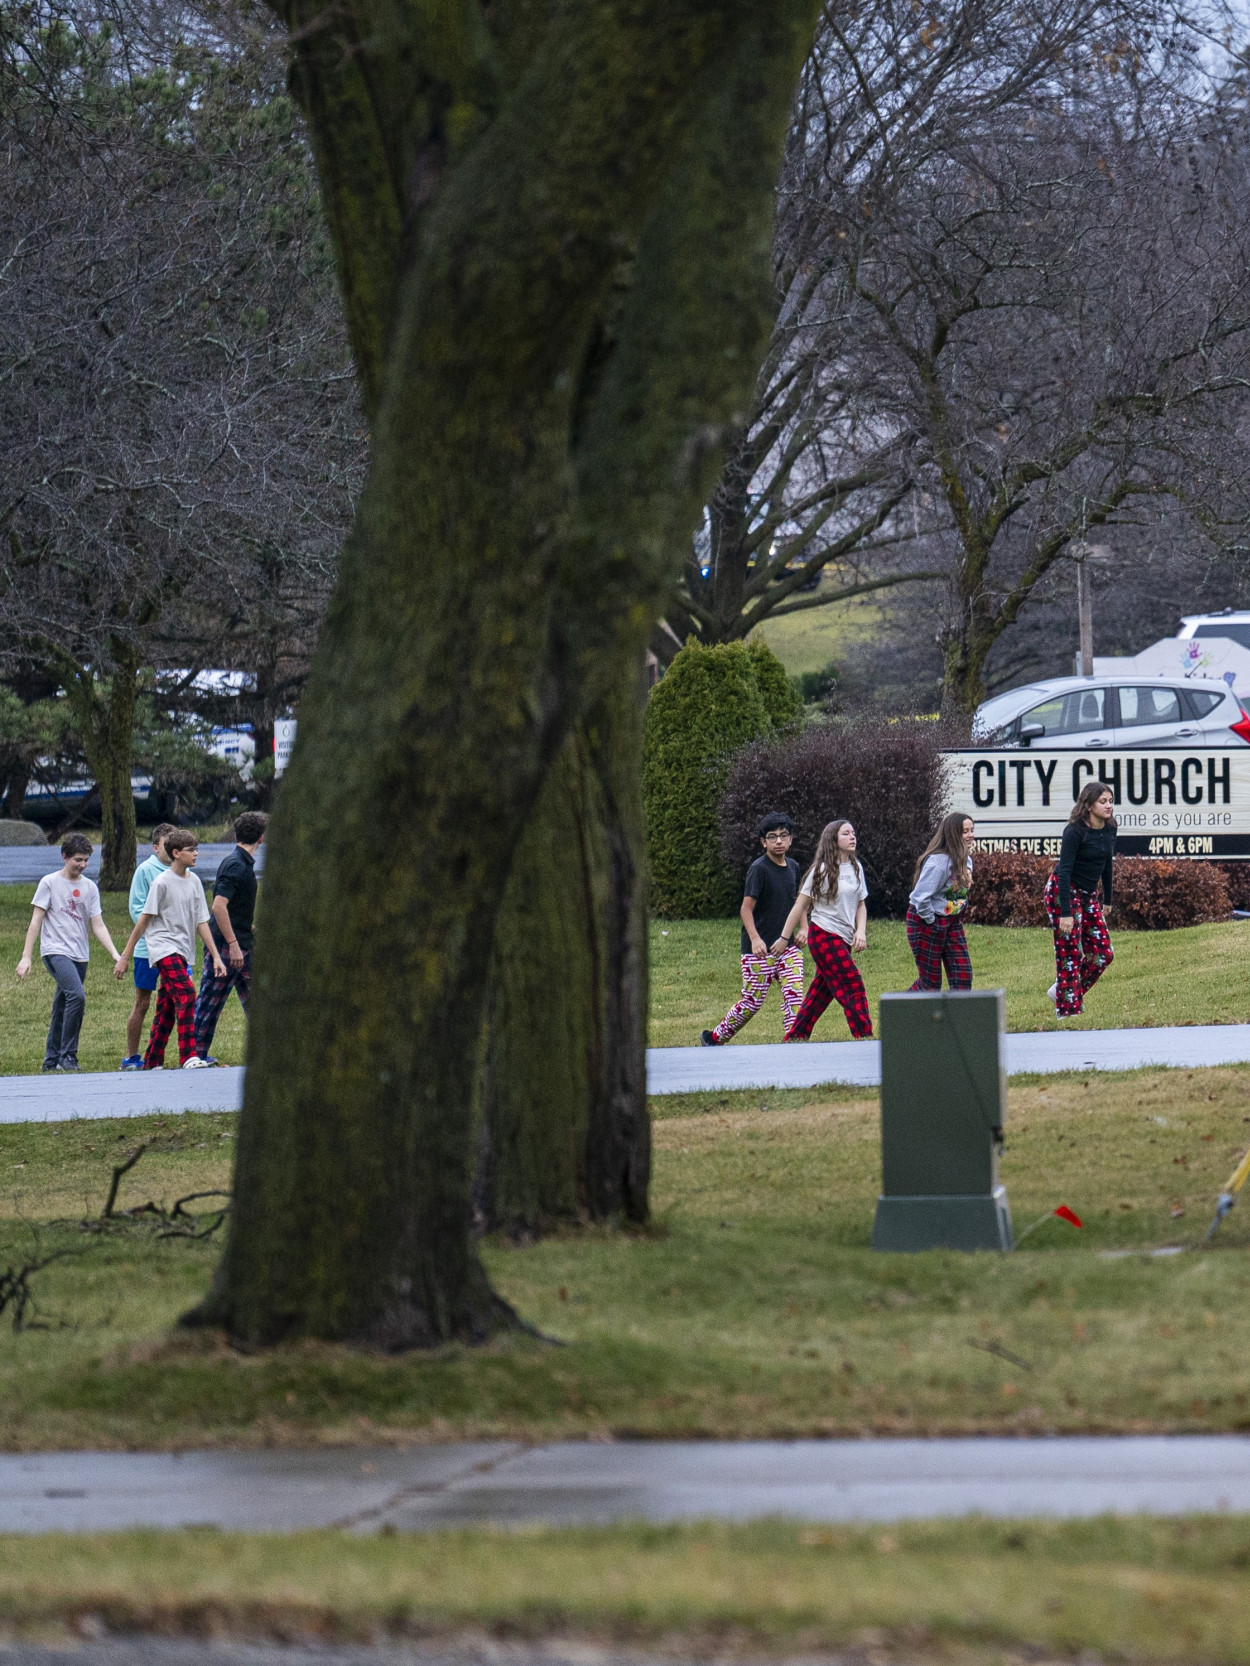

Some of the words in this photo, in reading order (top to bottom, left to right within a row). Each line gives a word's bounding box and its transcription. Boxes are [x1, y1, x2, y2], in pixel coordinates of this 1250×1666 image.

[278, 741, 292, 749] VISITO
[973, 760, 1057, 807] CITY
[1072, 757, 1231, 806] CHURCH
[1116, 813, 1147, 827] ome
[1152, 812, 1170, 826] as
[1175, 812, 1202, 829] you
[1207, 811, 1232, 826] are
[970, 838, 1018, 855] RISTMAS
[1020, 838, 1042, 855] EVE
[1148, 837, 1174, 854] 4PM
[1176, 837, 1186, 853] &
[1187, 836, 1213, 853] 6PM
